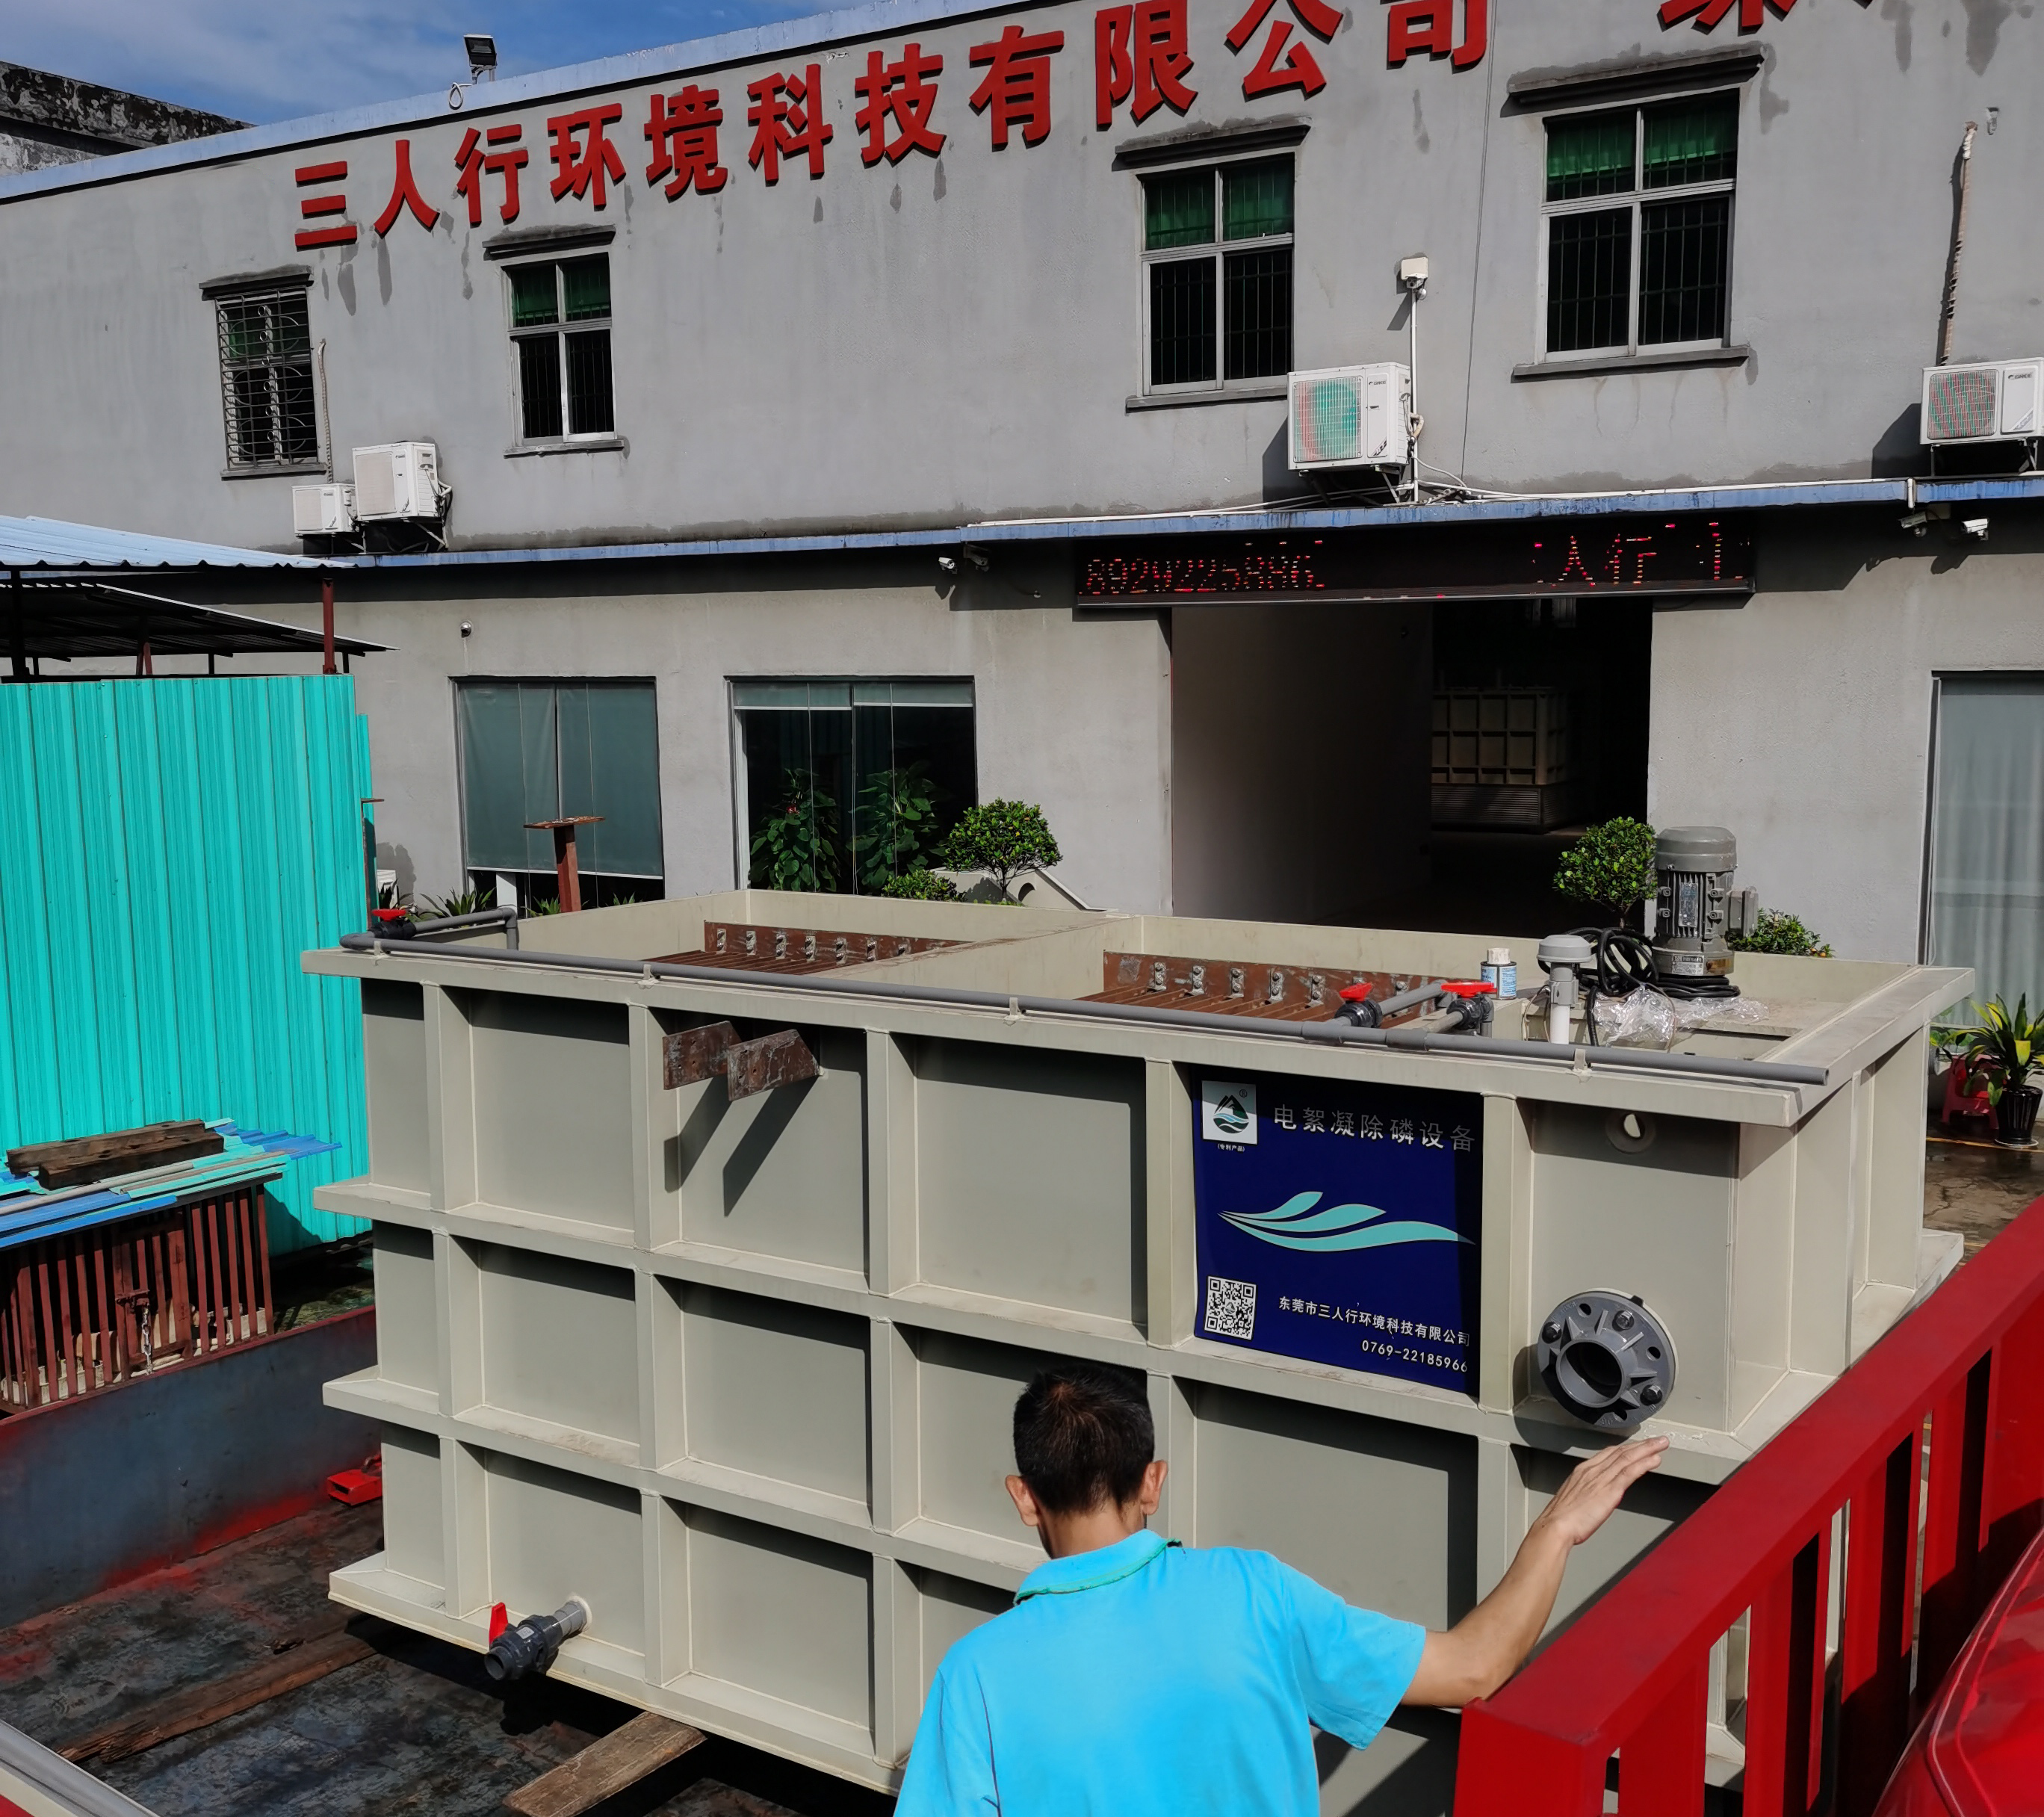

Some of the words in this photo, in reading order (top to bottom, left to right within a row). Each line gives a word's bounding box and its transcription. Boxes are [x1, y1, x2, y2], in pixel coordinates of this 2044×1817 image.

[1274, 1103, 1475, 1152] 电絮凝除磷设备
[1278, 1296, 1470, 1347] 东莞市三人行环境科技有限公司
[1361, 1340, 1468, 1373] 0769-22185966
